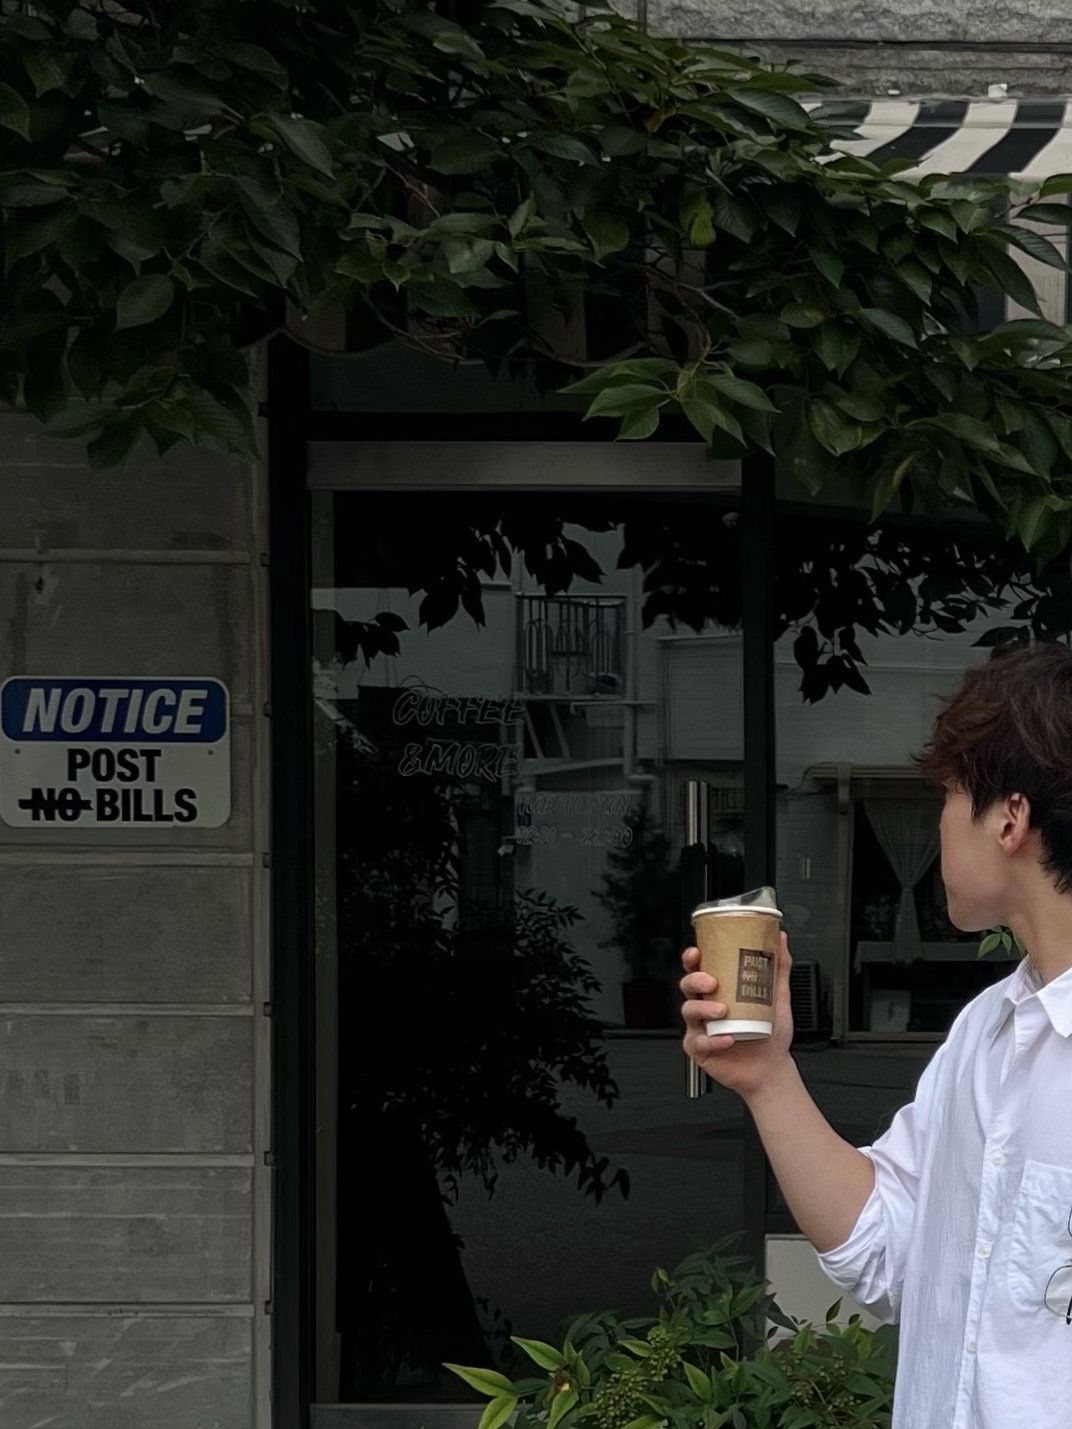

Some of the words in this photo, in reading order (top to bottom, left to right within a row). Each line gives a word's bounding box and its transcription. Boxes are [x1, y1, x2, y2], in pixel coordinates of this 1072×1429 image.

[22, 687, 209, 734] NOTICE
[392, 690, 526, 727] COFFEE
[66, 747, 162, 783] POST
[30, 787, 83, 822] NO
[96, 787, 198, 823] BILLS
